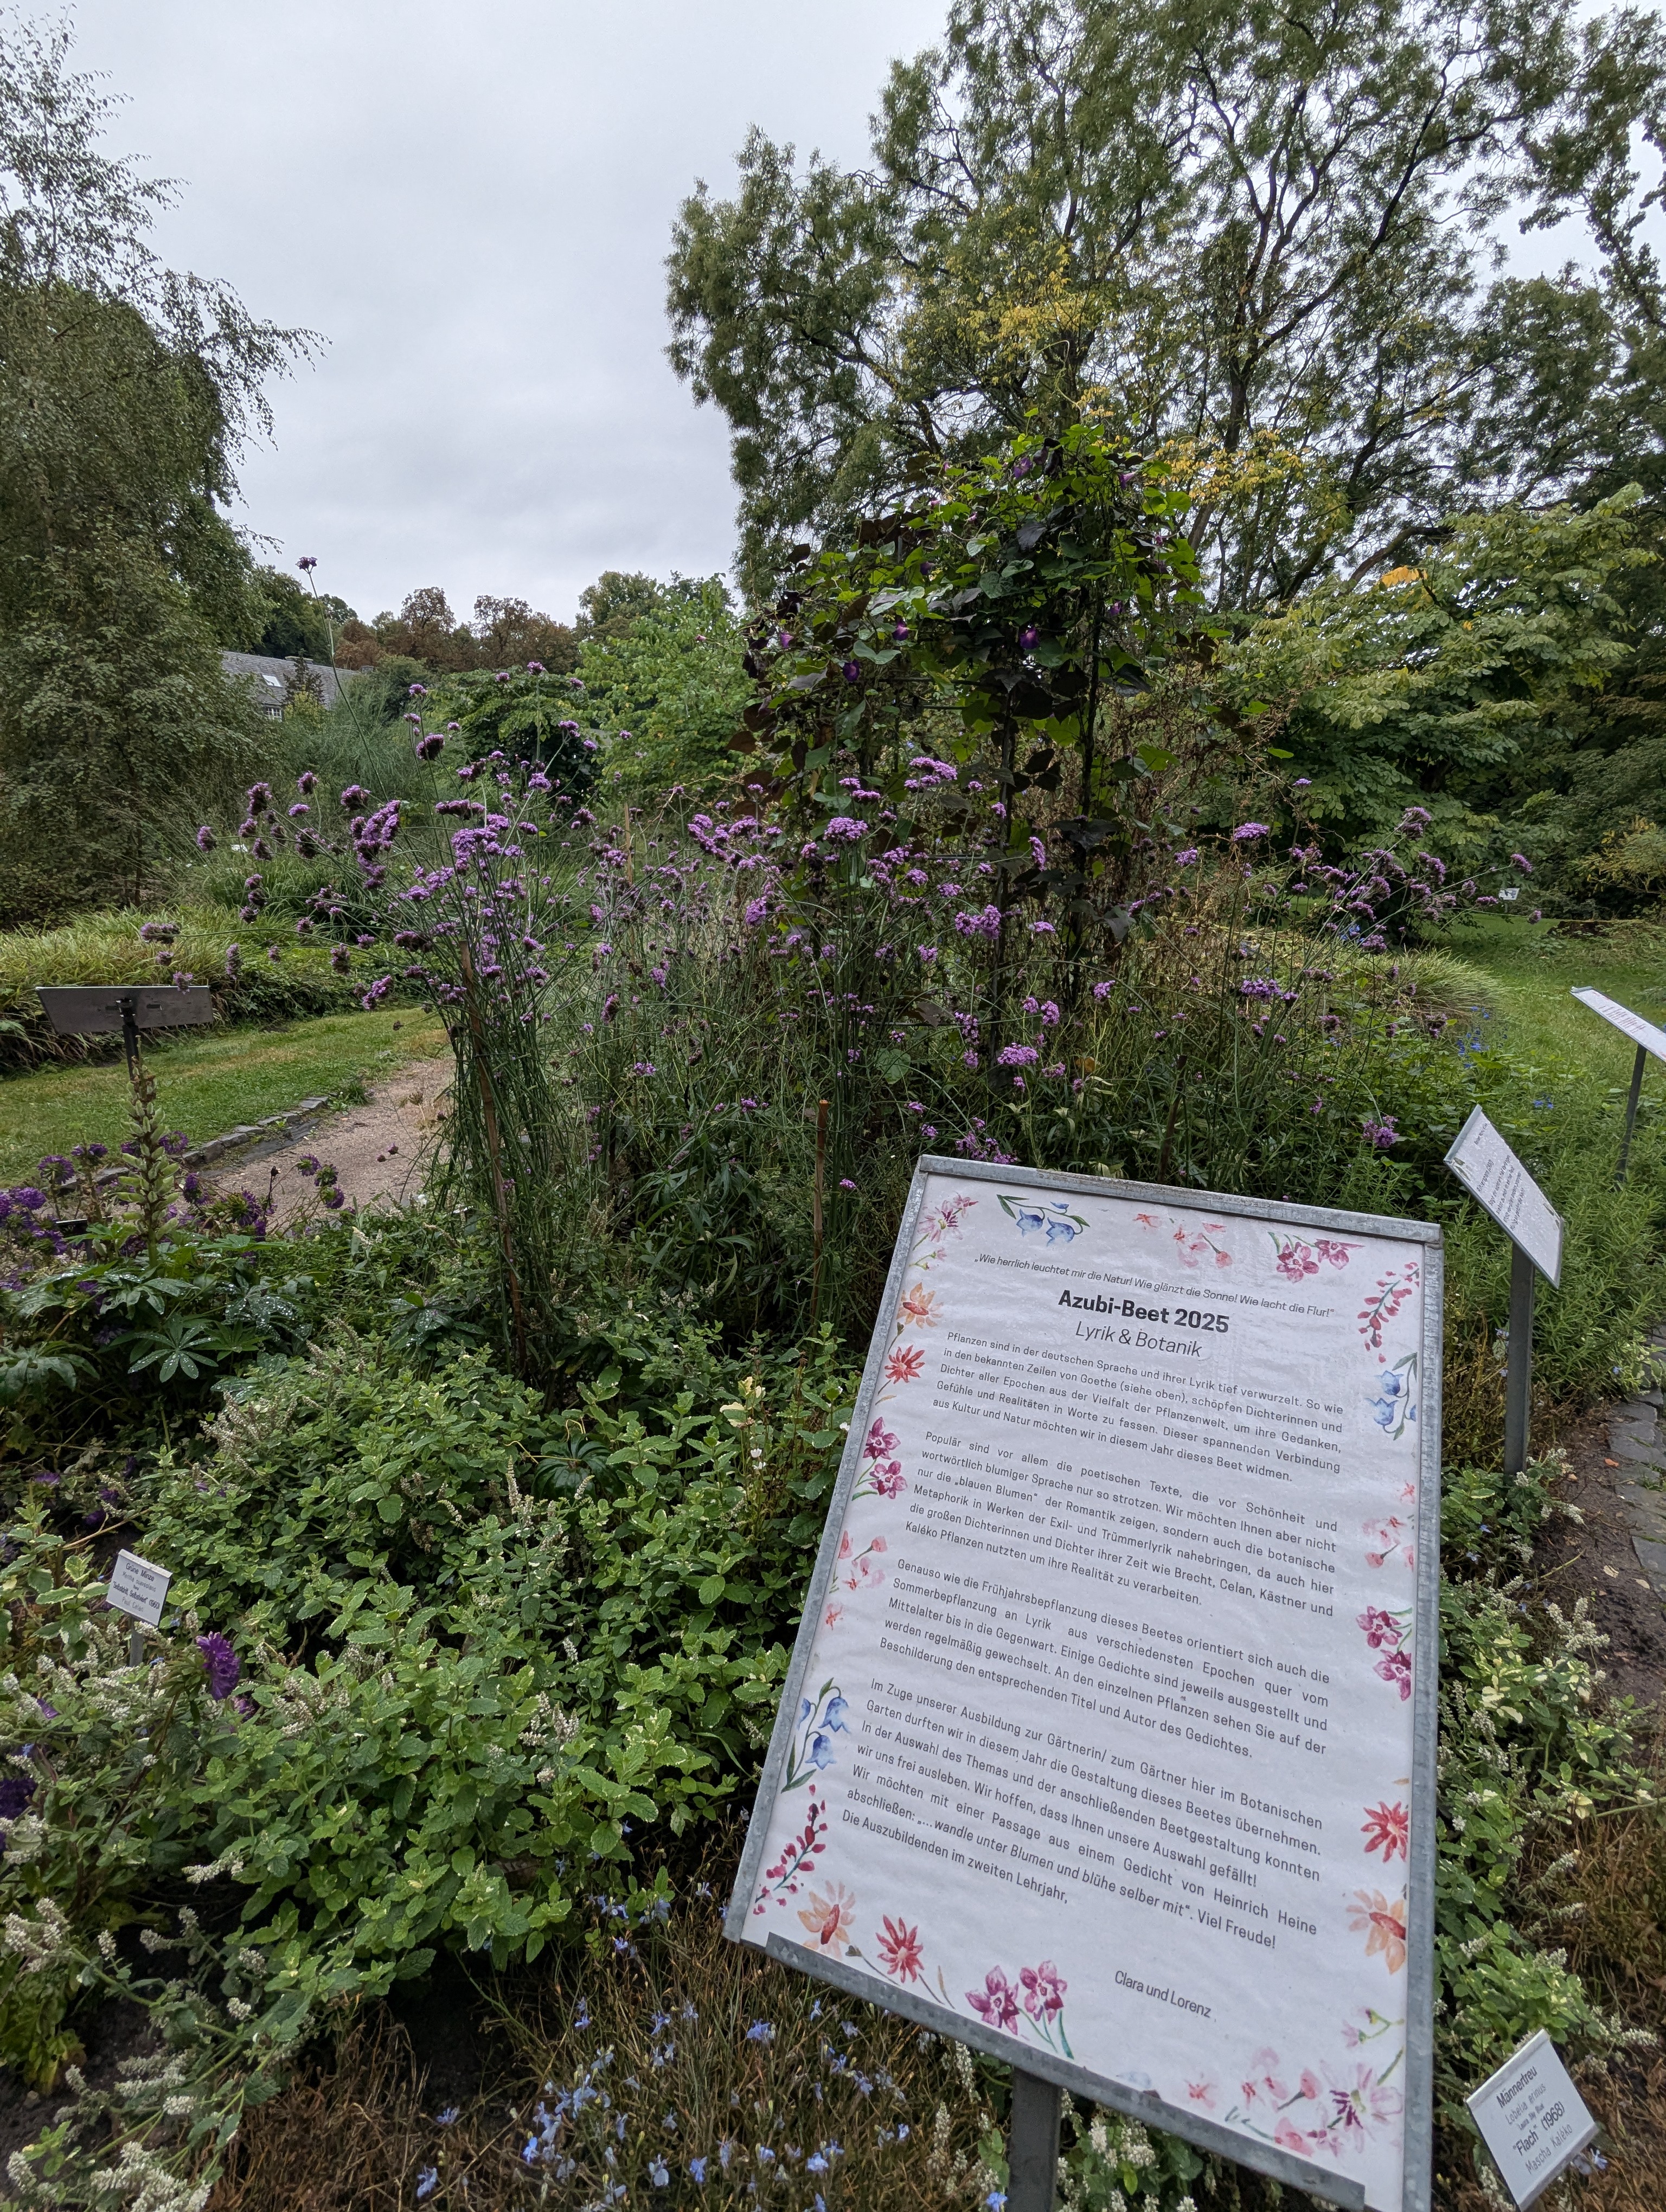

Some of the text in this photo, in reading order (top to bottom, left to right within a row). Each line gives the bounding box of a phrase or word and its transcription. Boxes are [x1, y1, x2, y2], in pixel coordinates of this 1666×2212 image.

[973, 1252, 996, 1264] „Wie
[996, 1255, 1030, 1269] herrlich
[1030, 1261, 1070, 1276] leuchtet
[1070, 1269, 1087, 1278] mir
[1087, 1270, 1102, 1281] die
[1102, 1272, 1133, 1286] Natur!
[1134, 1277, 1152, 1289] Wie
[1152, 1281, 1185, 1295] glänzt
[1185, 1286, 1201, 1297] die
[1202, 1288, 1238, 1303] Sonne!
[1239, 1294, 1259, 1306] Wie
[1260, 1297, 1287, 1311] lacht
[1288, 1302, 1305, 1314] die
[1057, 1289, 1230, 1333] Azubi-Beet 2025
[946, 1331, 1343, 1414] Pflanzen sind in der deutschen Sprache und ihrer Lyrik tief verwurzelt. So wie
[1075, 1320, 1203, 1361] Lyrik & Botanik
[932, 1399, 1292, 1482] aus Kultur und Natur möchten wir in diesem Jahr dieses Beet widmen.
[936, 1380, 1340, 1474] Gefühle und Realitäten in Worte zu fassen. Dieser spannenden Verbindung
[126, 1562, 138, 1574] Grüne
[905, 1520, 1202, 1605] Kaléko Pflanzen nutzten um ihre Realität zu verarbeiten.
[913, 1483, 1334, 1594] Metaphorik in Werken der Exil- und Trümmerlyrik nahebringen, da auch hier
[893, 1577, 1328, 1707] Sommerbepflanzung an Lyrik aus verschiedensten Epochen quer vom
[879, 1636, 1252, 1758] Beschilderung den entsprechenden Titel und Autor des Gedichtes.
[842, 1808, 1068, 1904] Die Auszubildenden im zweiten Lehrjahr,
[847, 1787, 915, 1821] abschließen:
[976, 1835, 1008, 1853] unter
[1009, 1843, 1054, 1870] Blumen
[1056, 1863, 1080, 1880] und
[1081, 1868, 1116, 1892] blühe
[1119, 1885, 1160, 1907] selber
[1197, 1908, 1222, 1930] Viel
[1225, 1918, 1276, 1949] Freude!
[853, 1763, 1317, 1935] Wir möchten mit einer Passage aus einem Gedicht von Heinrich Heine
[1114, 1970, 1212, 2018] Clara und Lorenz
[1496, 2066, 1537, 2108] Männertreu
[1504, 2084, 1546, 2125] Lobelia erinus
[1540, 2101, 1565, 2131] (1968)
[1525, 2146, 1552, 2175] Mascha
